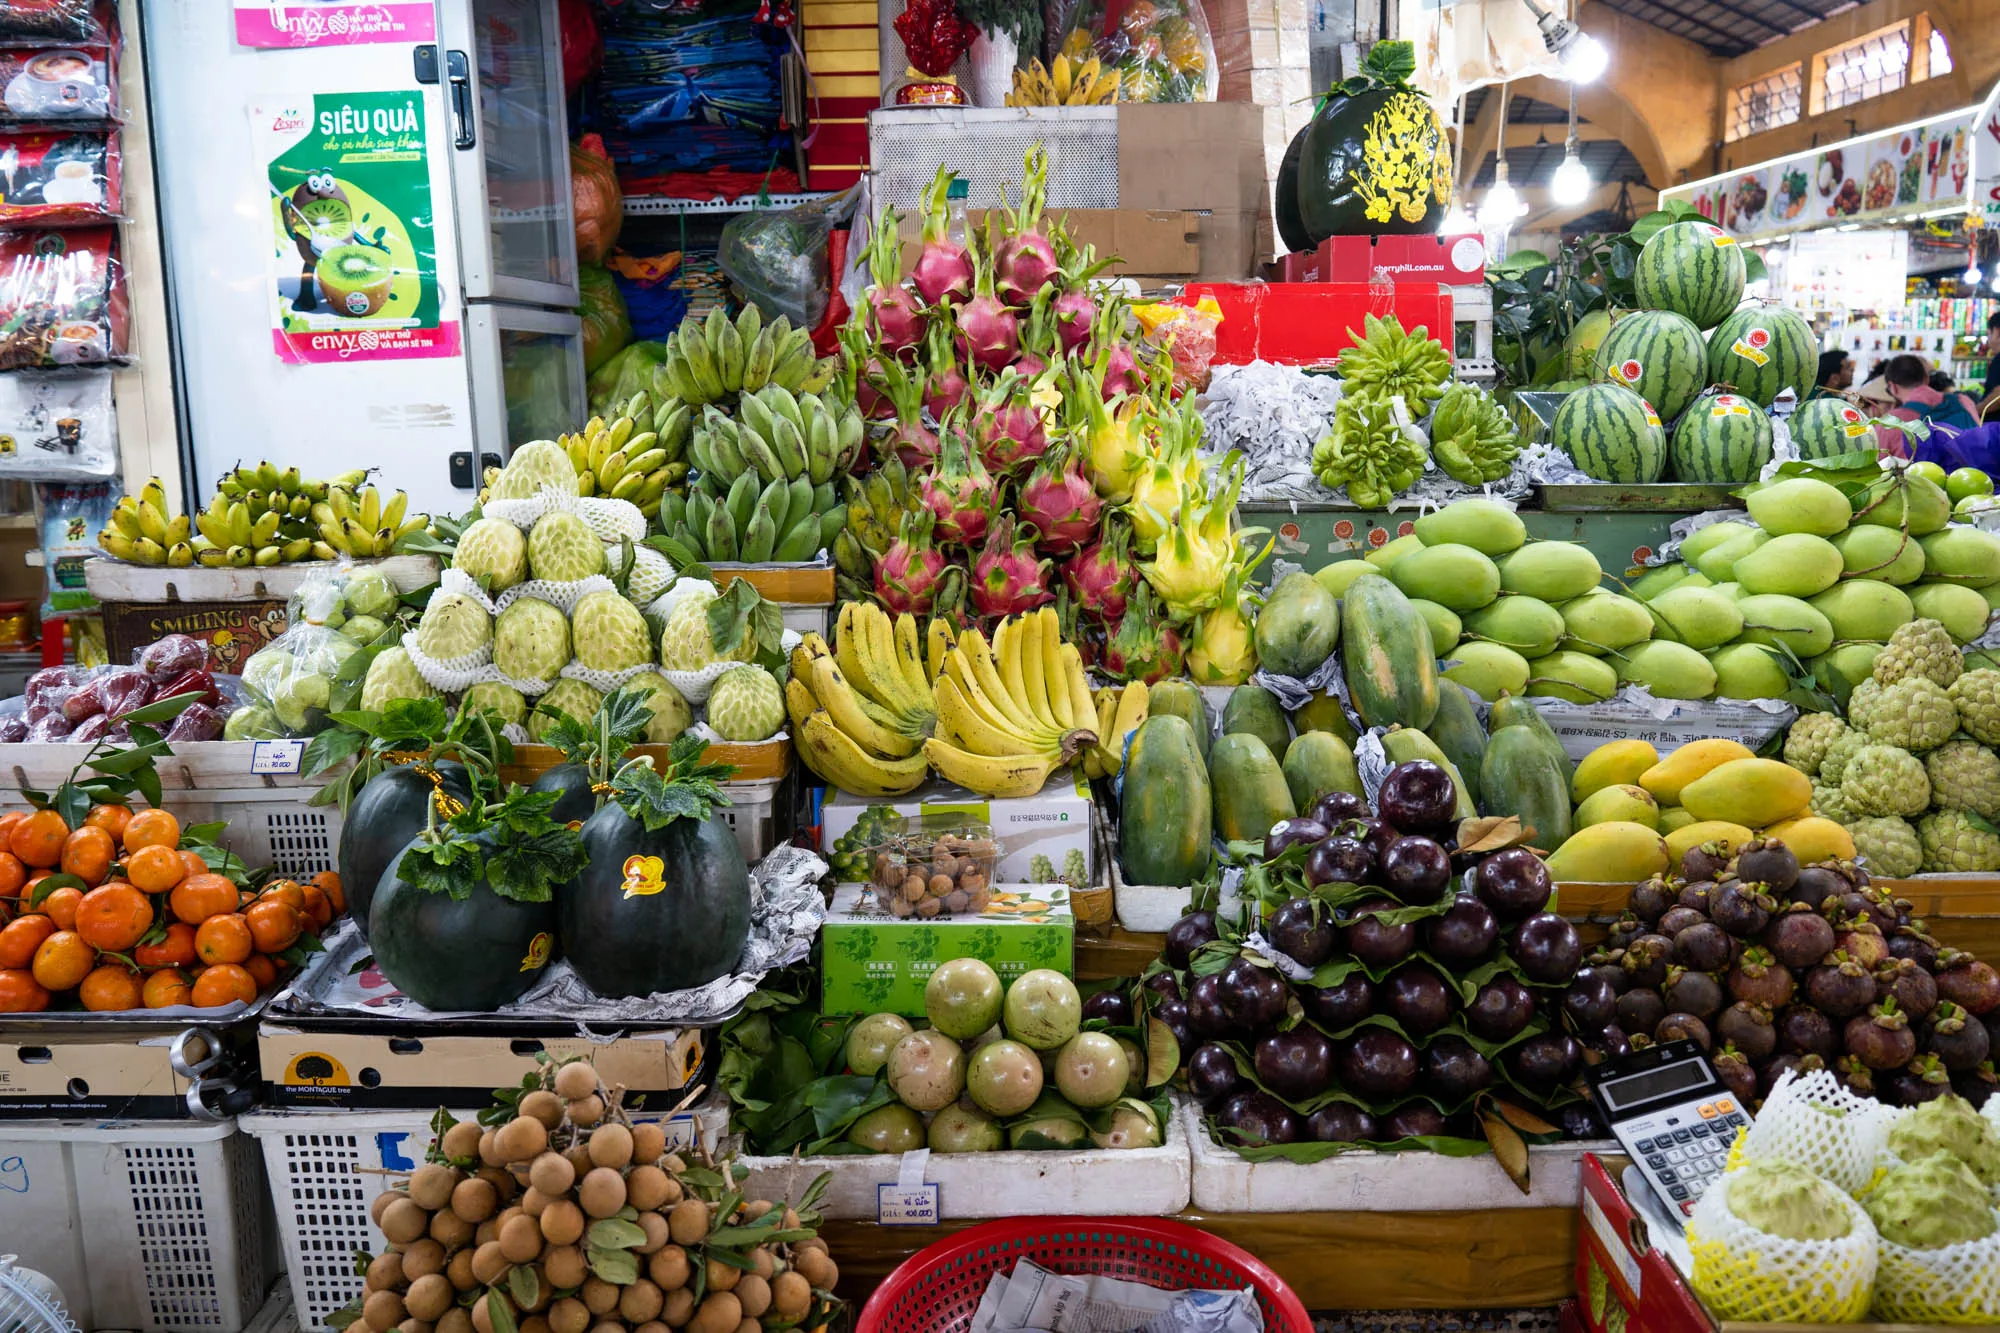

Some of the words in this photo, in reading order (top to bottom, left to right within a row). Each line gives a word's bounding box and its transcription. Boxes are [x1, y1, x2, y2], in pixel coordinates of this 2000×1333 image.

[283, 15, 329, 41] nvy
[273, 116, 305, 131] Zespri
[320, 104, 369, 135] SIÊU
[373, 101, 419, 136] QUẢ
[322, 136, 340, 150] cho
[355, 134, 375, 149] nhà
[1374, 264, 1445, 274] cherryhill.com.au
[396, 329, 412, 339] THỬ
[312, 334, 361, 357] envy
[380, 340, 392, 349] VÀ
[392, 340, 409, 350] BẠN
[420, 339, 433, 348] TIN
[150, 609, 242, 640] SMILING
